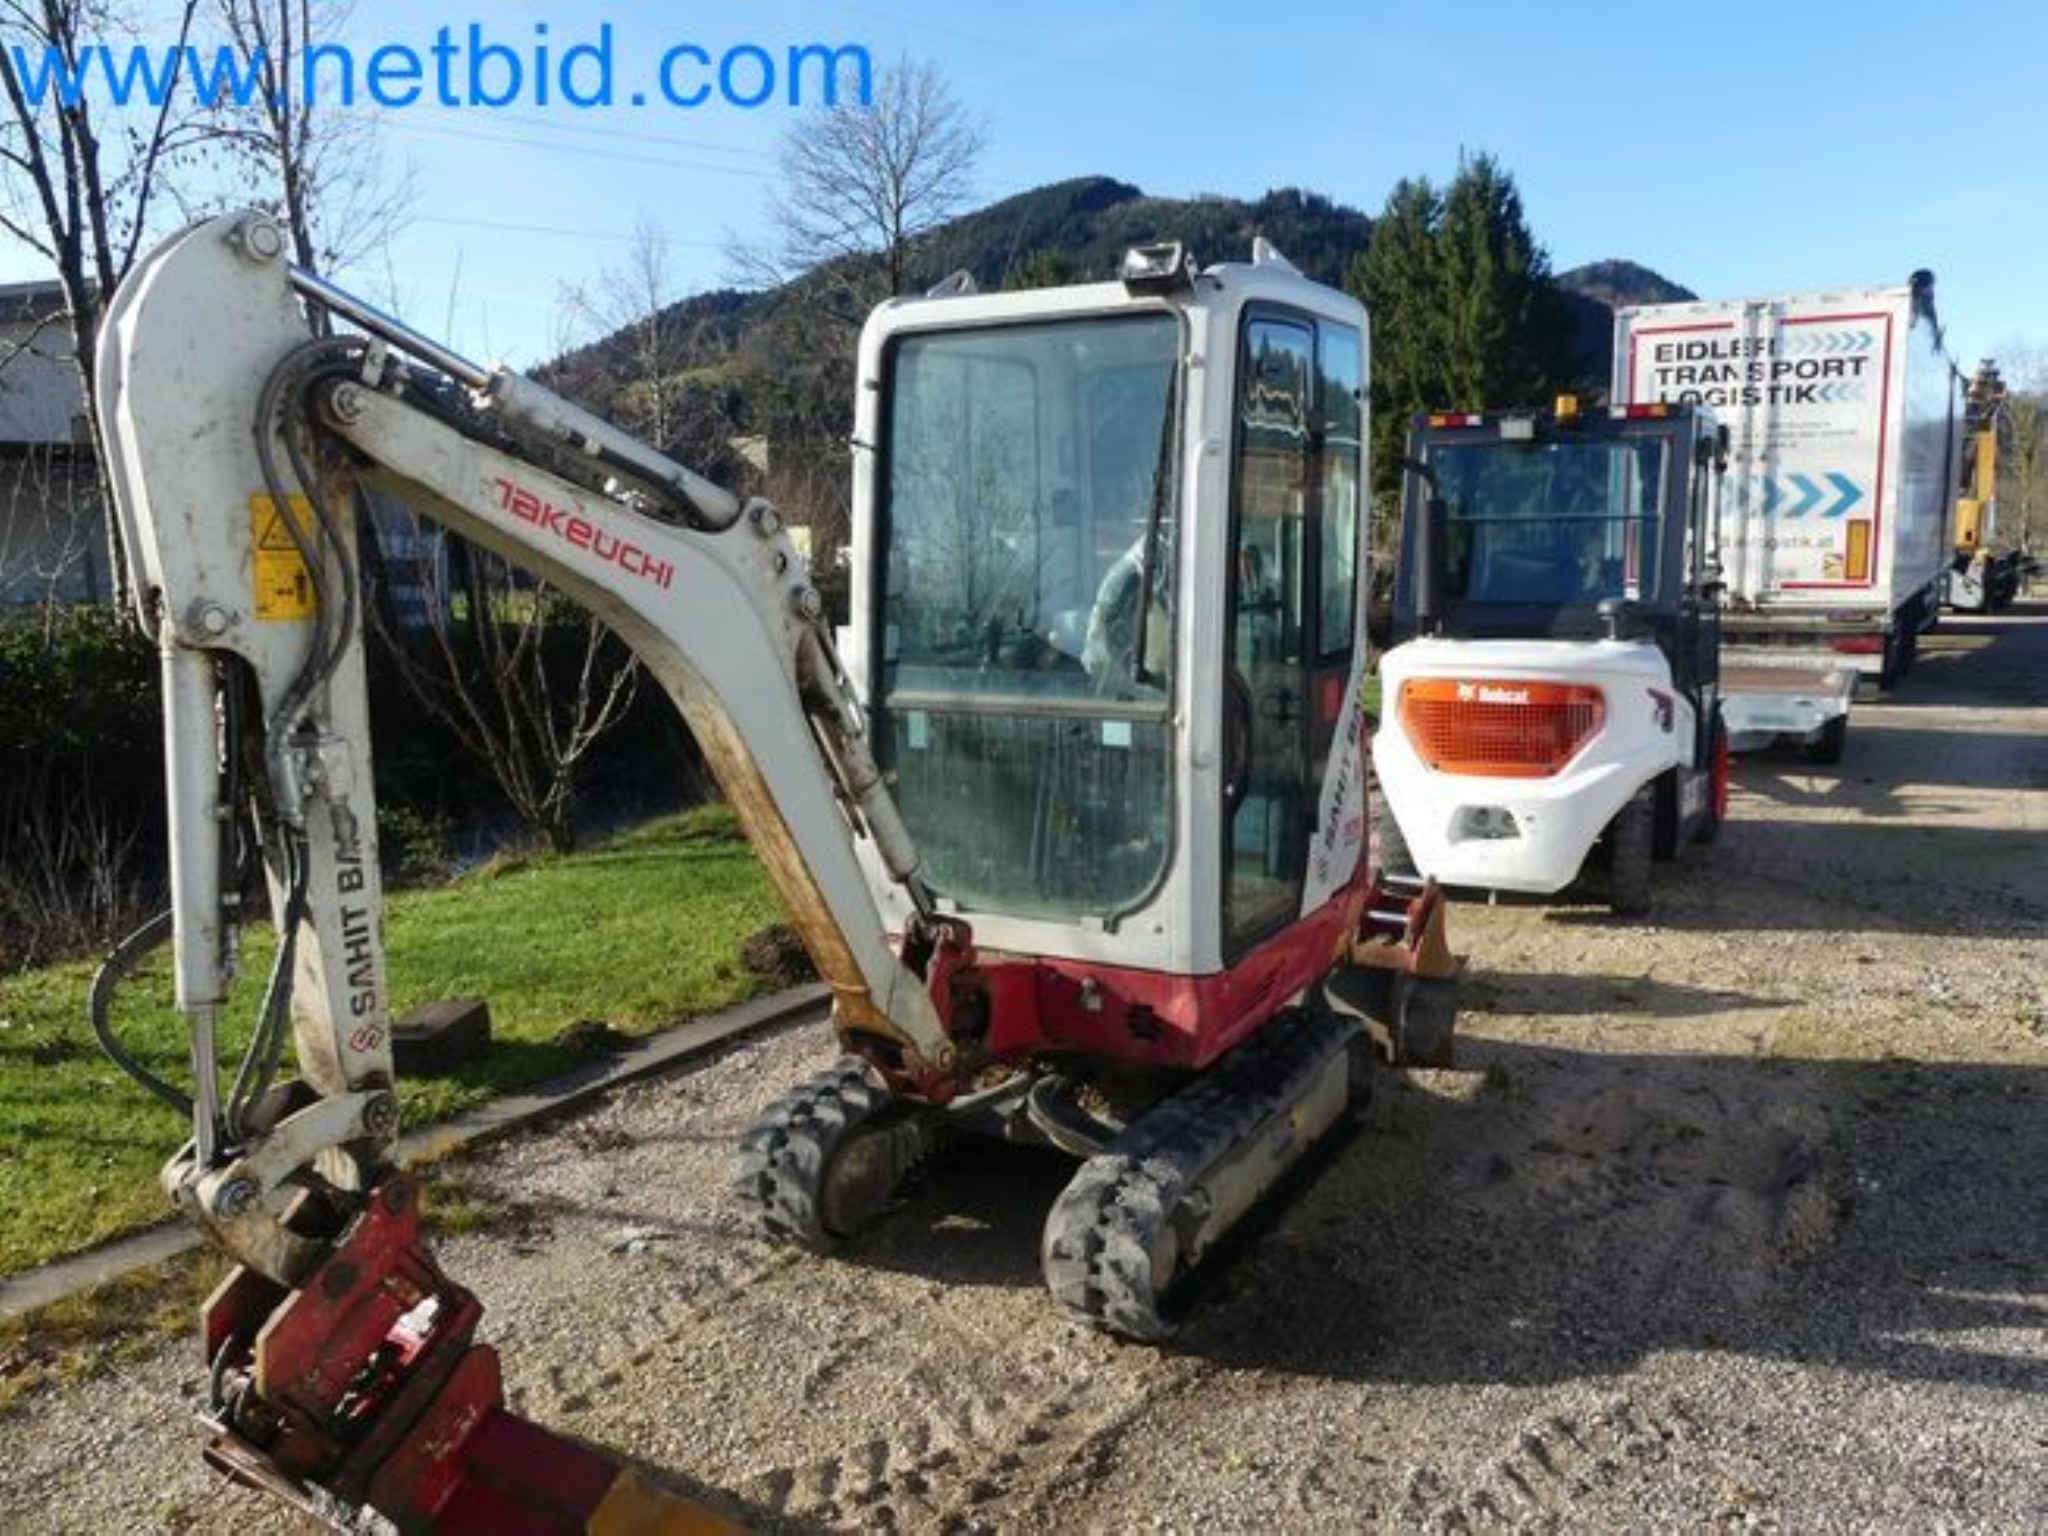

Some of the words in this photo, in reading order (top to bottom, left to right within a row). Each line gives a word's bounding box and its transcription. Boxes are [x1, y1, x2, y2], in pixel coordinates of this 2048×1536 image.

[1655, 356, 1869, 386] TRANSPORT
[1479, 685, 1530, 704] Bobcat
[341, 905, 376, 1017] SAHIT
